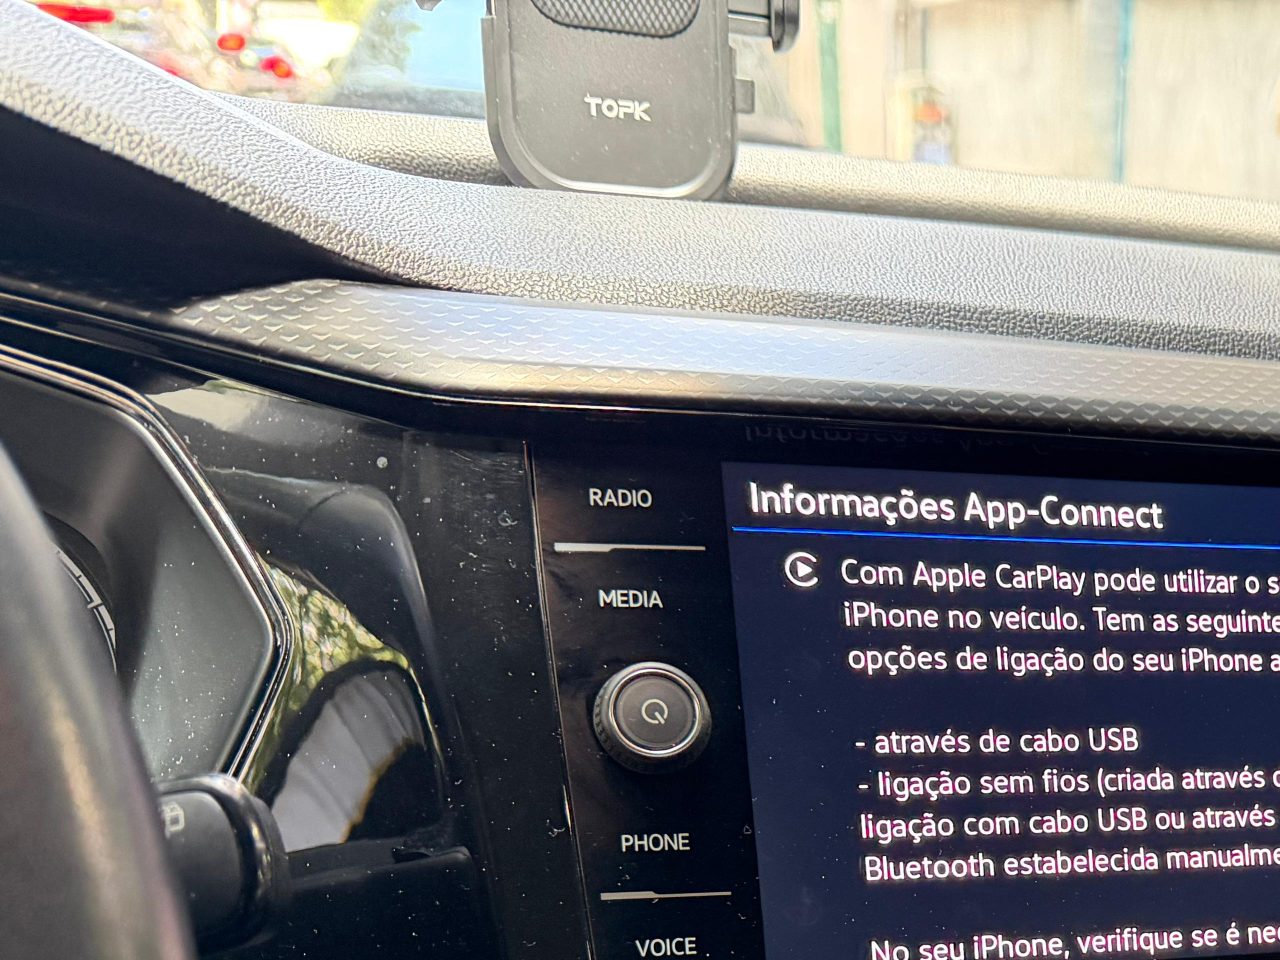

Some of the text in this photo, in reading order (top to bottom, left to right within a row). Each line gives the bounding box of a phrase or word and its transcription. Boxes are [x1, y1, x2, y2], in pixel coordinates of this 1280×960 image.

[583, 92, 652, 122] TOPK
[588, 488, 652, 508] RADIO
[749, 481, 1164, 530] Informações App-Connect
[840, 558, 904, 586] Com
[912, 560, 987, 593] Apple
[995, 563, 1086, 597] CarPlay
[1093, 567, 1156, 597] pode
[1163, 568, 1239, 594] utilizar
[1244, 575, 1260, 595] o
[599, 589, 664, 608] MEDIA
[843, 601, 939, 628] iPhone
[947, 609, 982, 629] no
[989, 605, 1085, 631] veículo.
[1091, 606, 1145, 632] Tem
[1152, 613, 1179, 632] as
[848, 644, 948, 676] opções
[955, 645, 988, 671] de
[996, 645, 1084, 677] ligação
[1092, 646, 1125, 672] do
[1132, 653, 1174, 672] seu
[1180, 647, 1263, 672] iPhone
[874, 728, 971, 754] através
[978, 728, 1011, 753] de
[1019, 728, 1080, 753] cabo
[1088, 727, 1139, 752] USB
[877, 770, 971, 802] ligação
[979, 775, 1034, 794] sem
[1041, 768, 1090, 793] fios
[1097, 766, 1175, 798] (criada
[1181, 764, 1266, 790] através
[860, 812, 955, 845] ligação
[963, 816, 1020, 836] com
[1028, 809, 1089, 834] cabo
[1097, 806, 1148, 832] USB
[1155, 811, 1186, 830] ou
[1192, 803, 1276, 829] através
[621, 833, 691, 852] PHONE
[864, 852, 995, 882] Bluetooth
[1003, 846, 1159, 876] estabelecida
[635, 937, 697, 957] VOICE
[972, 934, 1070, 960] iPhone,
[1076, 927, 1183, 956] verifique
[1191, 928, 1218, 948] se
[1225, 921, 1241, 946] é
